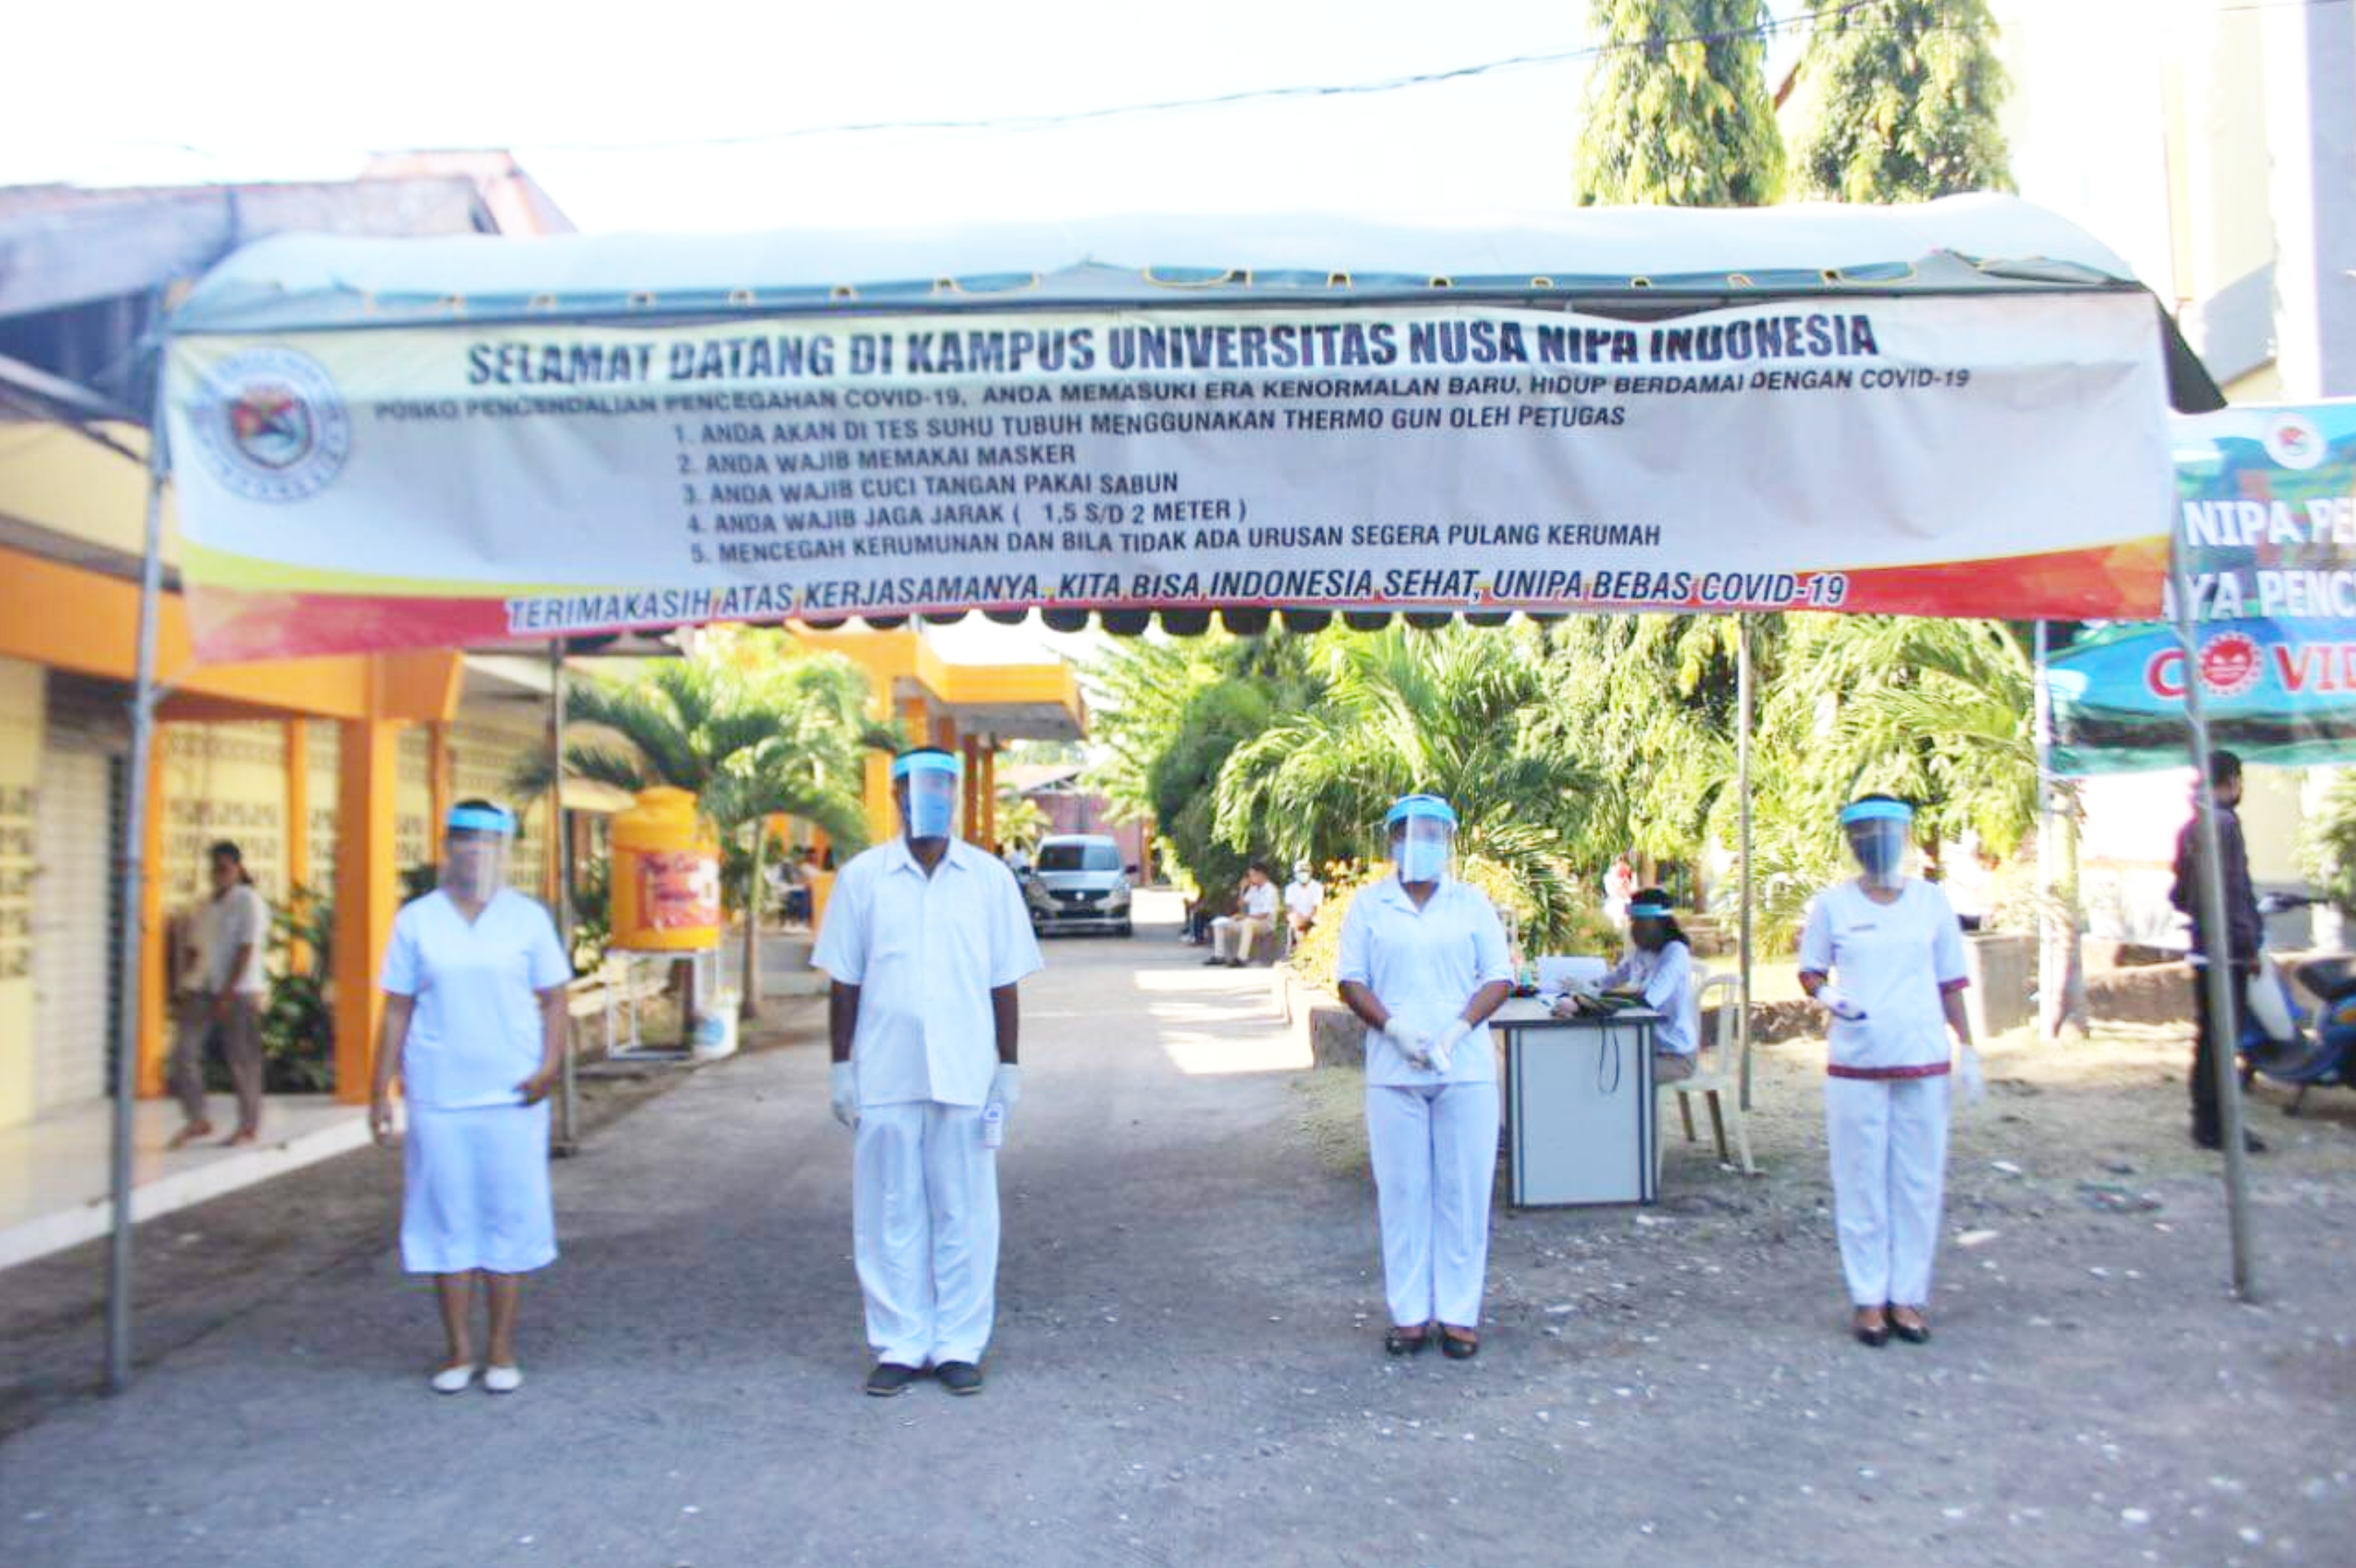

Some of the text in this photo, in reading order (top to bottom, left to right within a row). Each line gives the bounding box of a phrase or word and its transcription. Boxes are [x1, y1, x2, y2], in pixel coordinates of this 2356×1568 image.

[467, 314, 1879, 384] SELAMAT DATANG DI KAMPUS UNIVERSITAS NUSA NIPA INDONESIA
[983, 384, 1052, 403] ANDA
[1061, 381, 1195, 402] MEMASUKI
[1205, 380, 1255, 400] ERA
[1262, 377, 1439, 400] KENORMALAN
[1529, 373, 1608, 394] HIDUP
[1613, 372, 1744, 394] BERDAMAI
[1751, 368, 1852, 390] DENGAN
[1861, 367, 1970, 388] COVID-19
[701, 422, 765, 444] ANDA
[772, 420, 837, 443] AKAN
[845, 420, 868, 440] DI
[875, 418, 919, 439] TES
[926, 416, 993, 438] SUHU
[1002, 414, 1082, 437] TUBUH
[1090, 408, 1275, 434] MENGGUNAKAN
[1284, 408, 1384, 430] THERMO
[1392, 408, 1442, 430] GUN
[1450, 407, 1510, 427] OLEH
[1519, 405, 1625, 427] PETUGAS
[707, 452, 770, 474] ANDA
[777, 450, 850, 473] WAJIB
[859, 447, 970, 470] MEMAKAI
[977, 444, 1076, 466] MASKER
[710, 483, 773, 504] ANDA
[779, 479, 853, 503] WAJIB
[861, 476, 916, 498] CUCI
[925, 474, 1015, 497] TANGAN
[1024, 474, 1091, 494] PAKAI
[1100, 472, 1177, 494] SABUN
[714, 512, 776, 534] ANDA
[783, 509, 855, 532] WAJIB
[863, 506, 922, 528] JAGA
[930, 503, 1003, 525] JARAK
[1085, 502, 1124, 524] S/D
[1132, 504, 1144, 524] 2
[1153, 500, 1231, 522] METER
[2184, 499, 2305, 546] NIPA
[719, 539, 844, 564] MENCEGAH
[853, 533, 998, 557] KERUMUNAN
[1007, 532, 1053, 552] DAN
[1063, 532, 1112, 551] BILA
[1119, 529, 1185, 552] TIDAK
[1194, 528, 1240, 549] ADA
[1248, 525, 1343, 547] URUSAN
[1351, 524, 1440, 546] SEGERA
[1448, 524, 1540, 546] PULANG
[1547, 524, 1661, 546] KERUMAH
[509, 587, 712, 628] TERIMAKASIH
[722, 583, 793, 613] ATAS
[1060, 573, 1119, 599] KITA
[1131, 572, 1199, 597] BISA
[1210, 571, 1372, 597] INDONESIA
[1493, 569, 1582, 597] UNIPA
[1592, 571, 1689, 600] BEBAS
[1701, 573, 1845, 603] COVID-19
